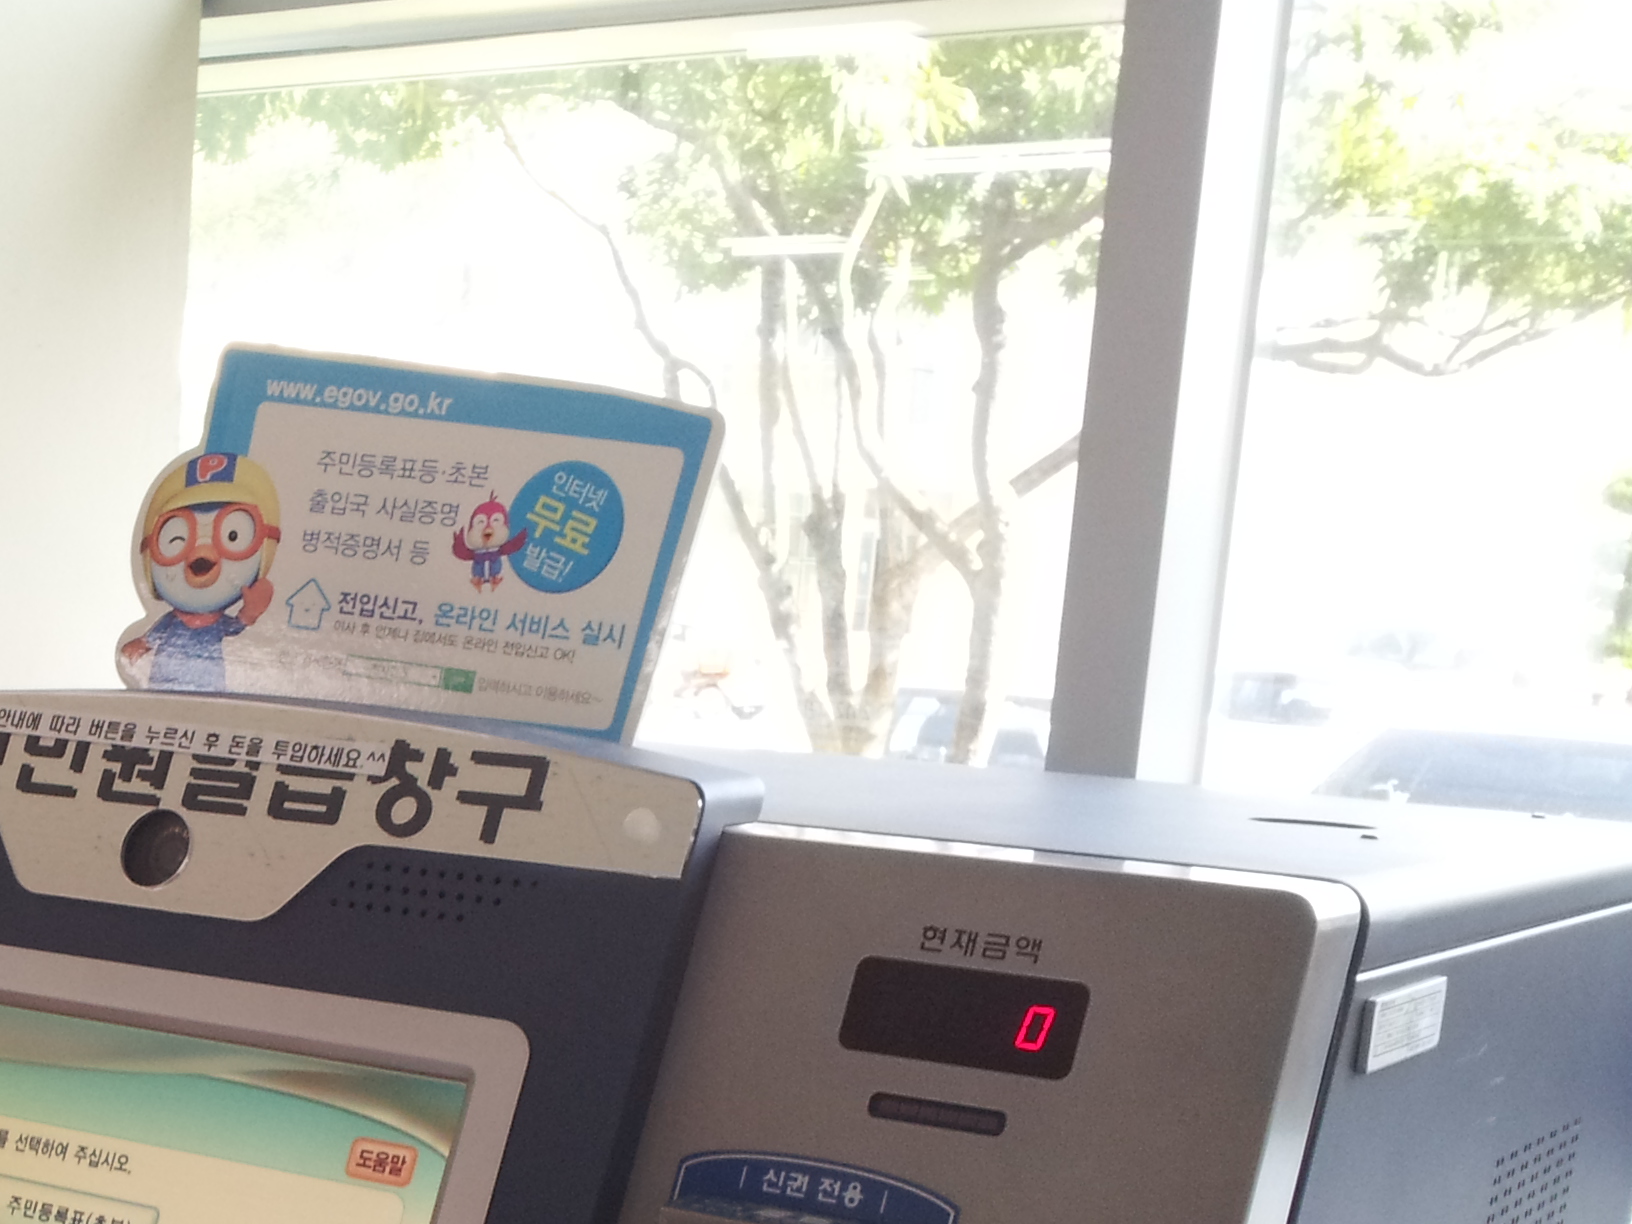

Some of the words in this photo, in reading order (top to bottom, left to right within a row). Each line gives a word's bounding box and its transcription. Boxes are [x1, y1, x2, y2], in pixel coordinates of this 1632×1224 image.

[267, 379, 453, 416] www.egov.go.kr
[309, 489, 370, 518] 출입국
[376, 497, 460, 528] 사실증명
[552, 471, 609, 512] 인터넷
[526, 495, 598, 555] 무료
[302, 529, 402, 562] 병적증명서
[409, 540, 431, 566] 등
[523, 543, 574, 583] 발급!
[338, 591, 423, 624] 전입신고,
[434, 602, 499, 633] 온라인
[506, 612, 571, 641] 서비스
[581, 620, 627, 650] 실시
[462, 636, 498, 654] 온라인
[502, 642, 550, 660] 전입신고
[49, 713, 82, 735] 따라
[88, 718, 136, 743] 버튼을
[145, 725, 195, 750] 누르신
[203, 731, 221, 753] 후
[228, 734, 264, 758] 돈을
[921, 924, 1044, 964] 현재금액
[1014, 1004, 1057, 1052] 0
[15, 1132, 70, 1161] 선택하여
[74, 1144, 132, 1176] 주십시오.
[356, 1148, 407, 1178] 도움말
[761, 1168, 809, 1198] 신권
[818, 1176, 864, 1208] 전용
